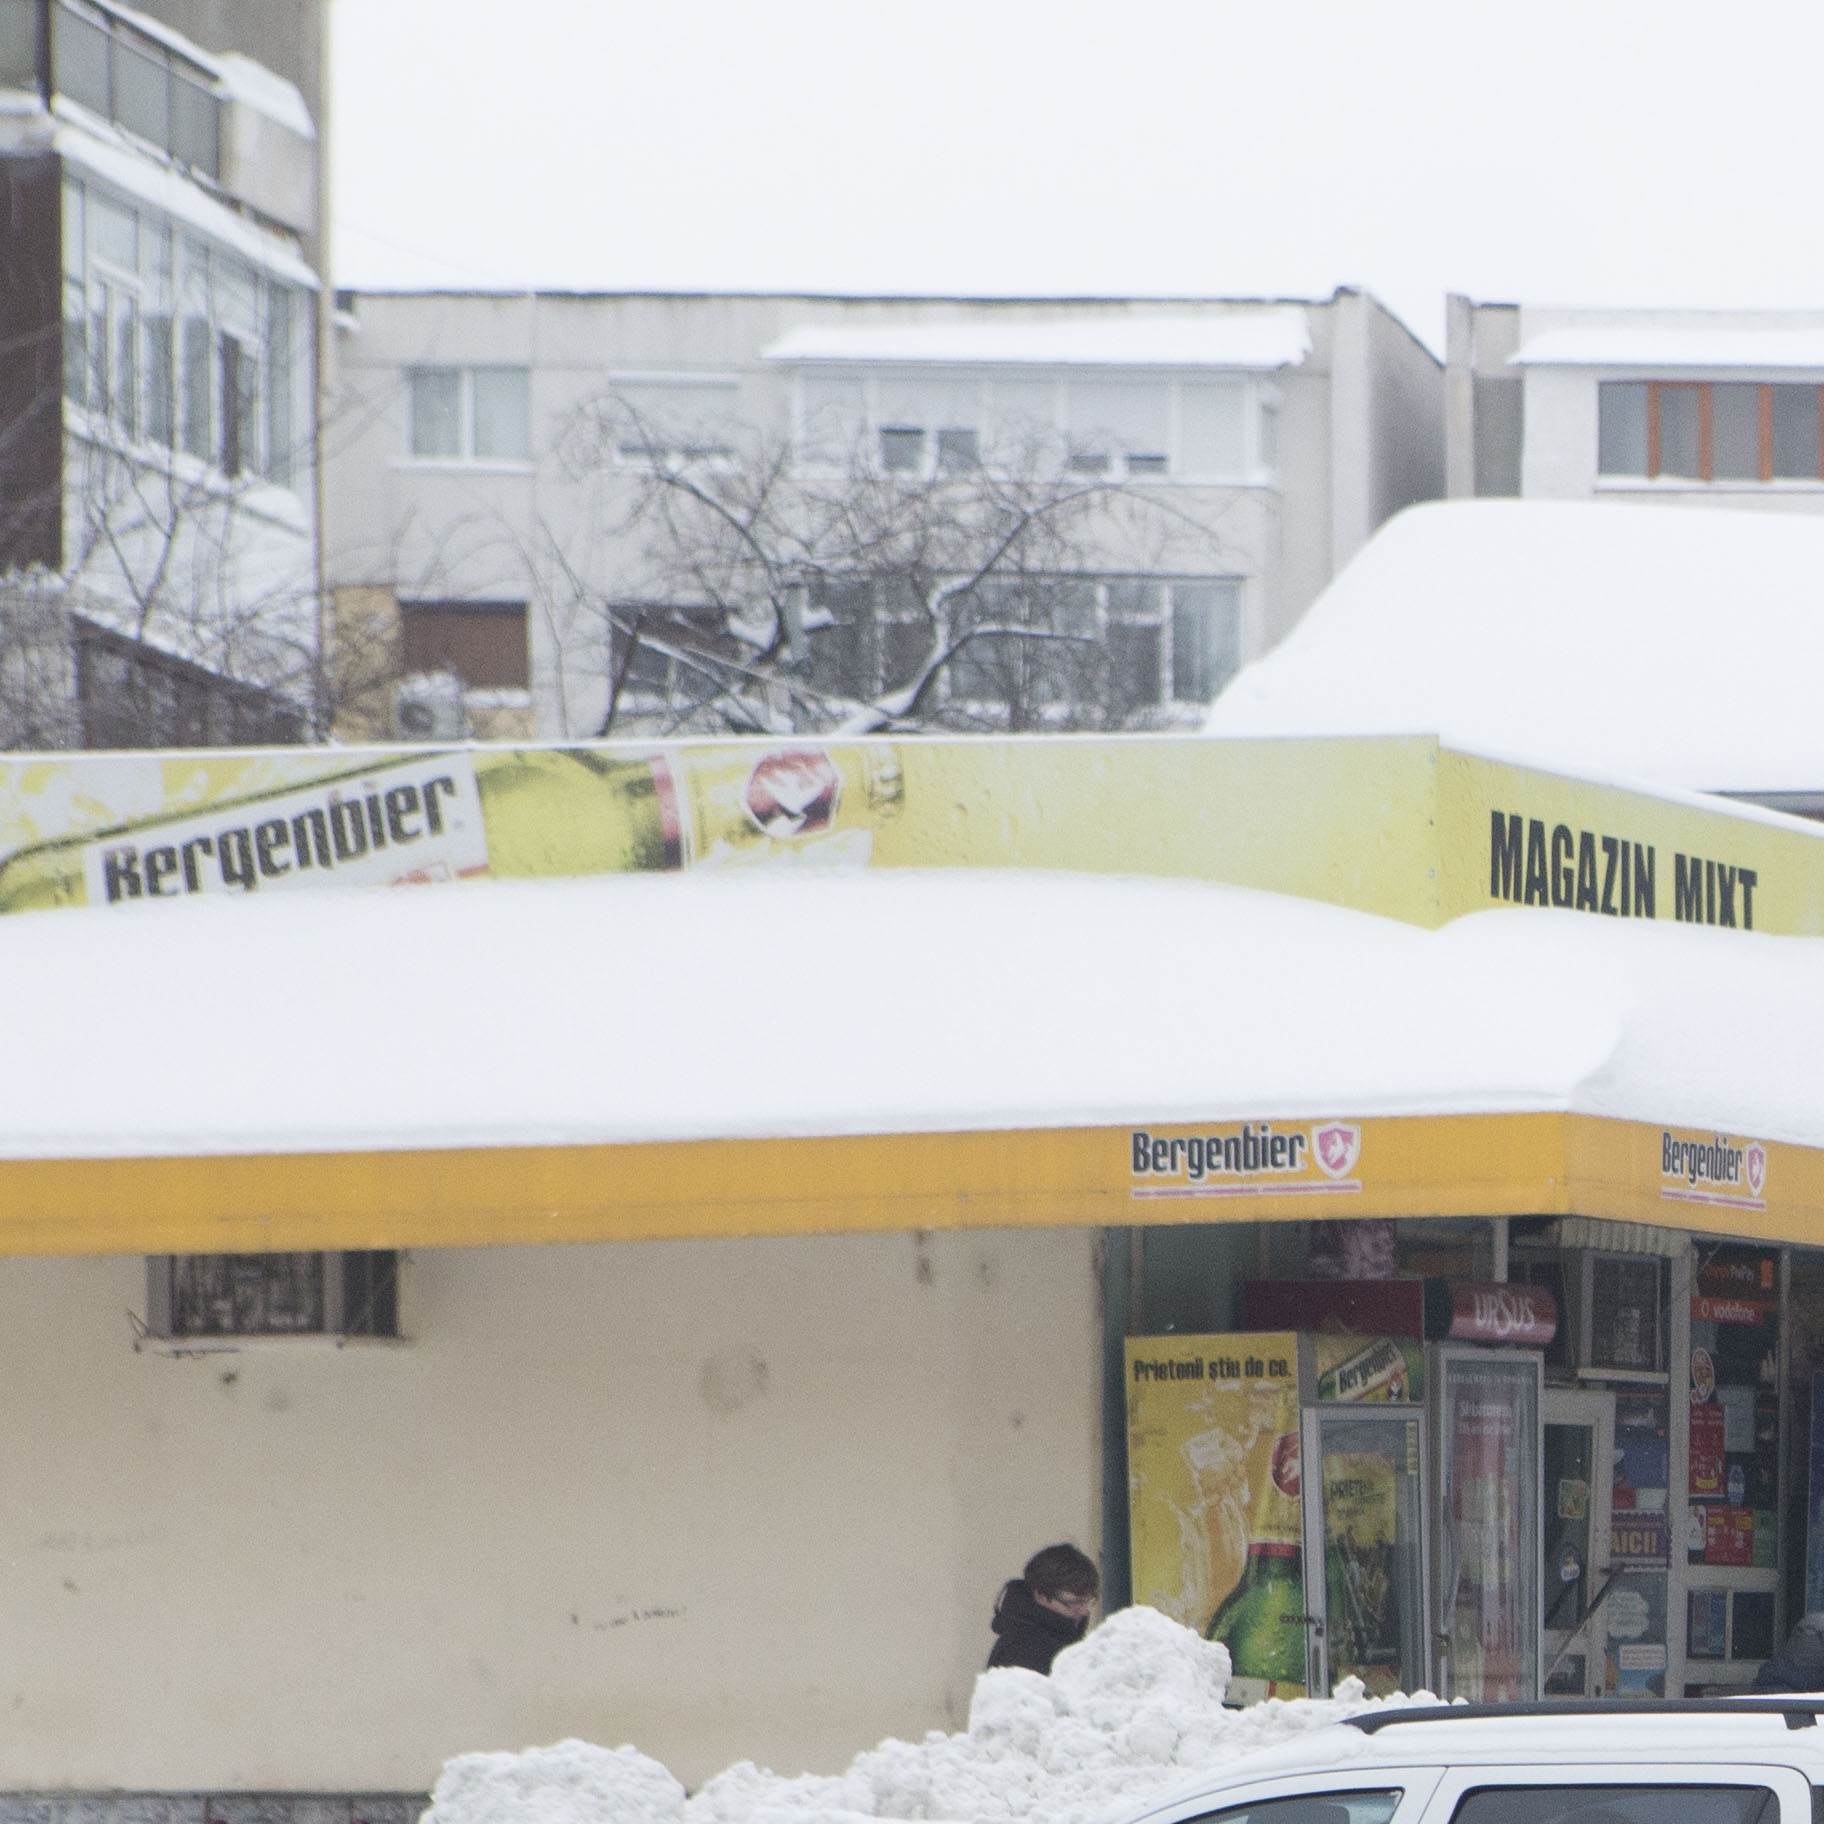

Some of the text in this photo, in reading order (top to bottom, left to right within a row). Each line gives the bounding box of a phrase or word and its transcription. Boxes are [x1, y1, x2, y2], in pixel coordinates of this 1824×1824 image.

[105, 775, 455, 904] Bergenbier
[1490, 810, 1757, 930] MAGAZIN MIXT
[1132, 1124, 1305, 1179] Bergenbier
[1662, 1131, 1742, 1184] Bergenbier
[1474, 1290, 1536, 1336] URSUS
[1245, 1355, 1264, 1378] de
